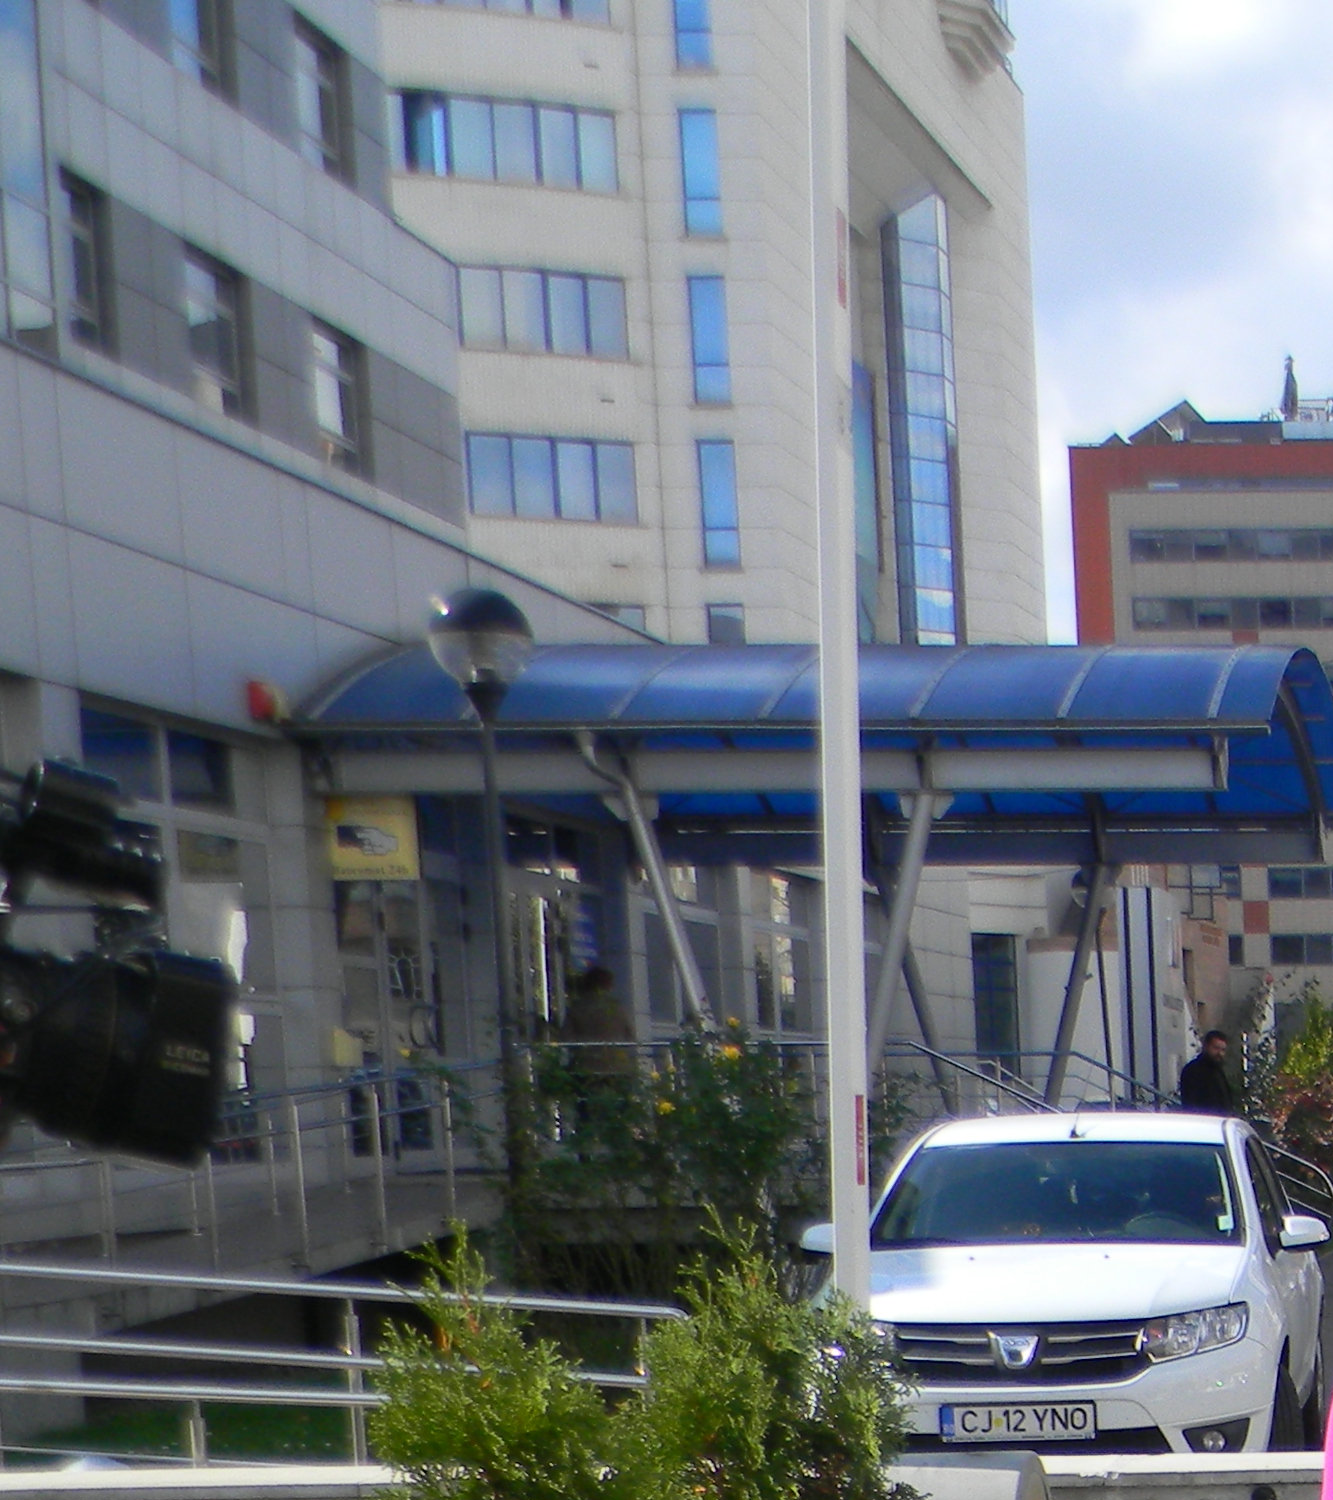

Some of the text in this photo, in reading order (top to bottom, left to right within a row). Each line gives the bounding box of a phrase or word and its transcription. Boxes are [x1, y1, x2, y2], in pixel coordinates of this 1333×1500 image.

[961, 1407, 1087, 1433] CJ 12 YNO
